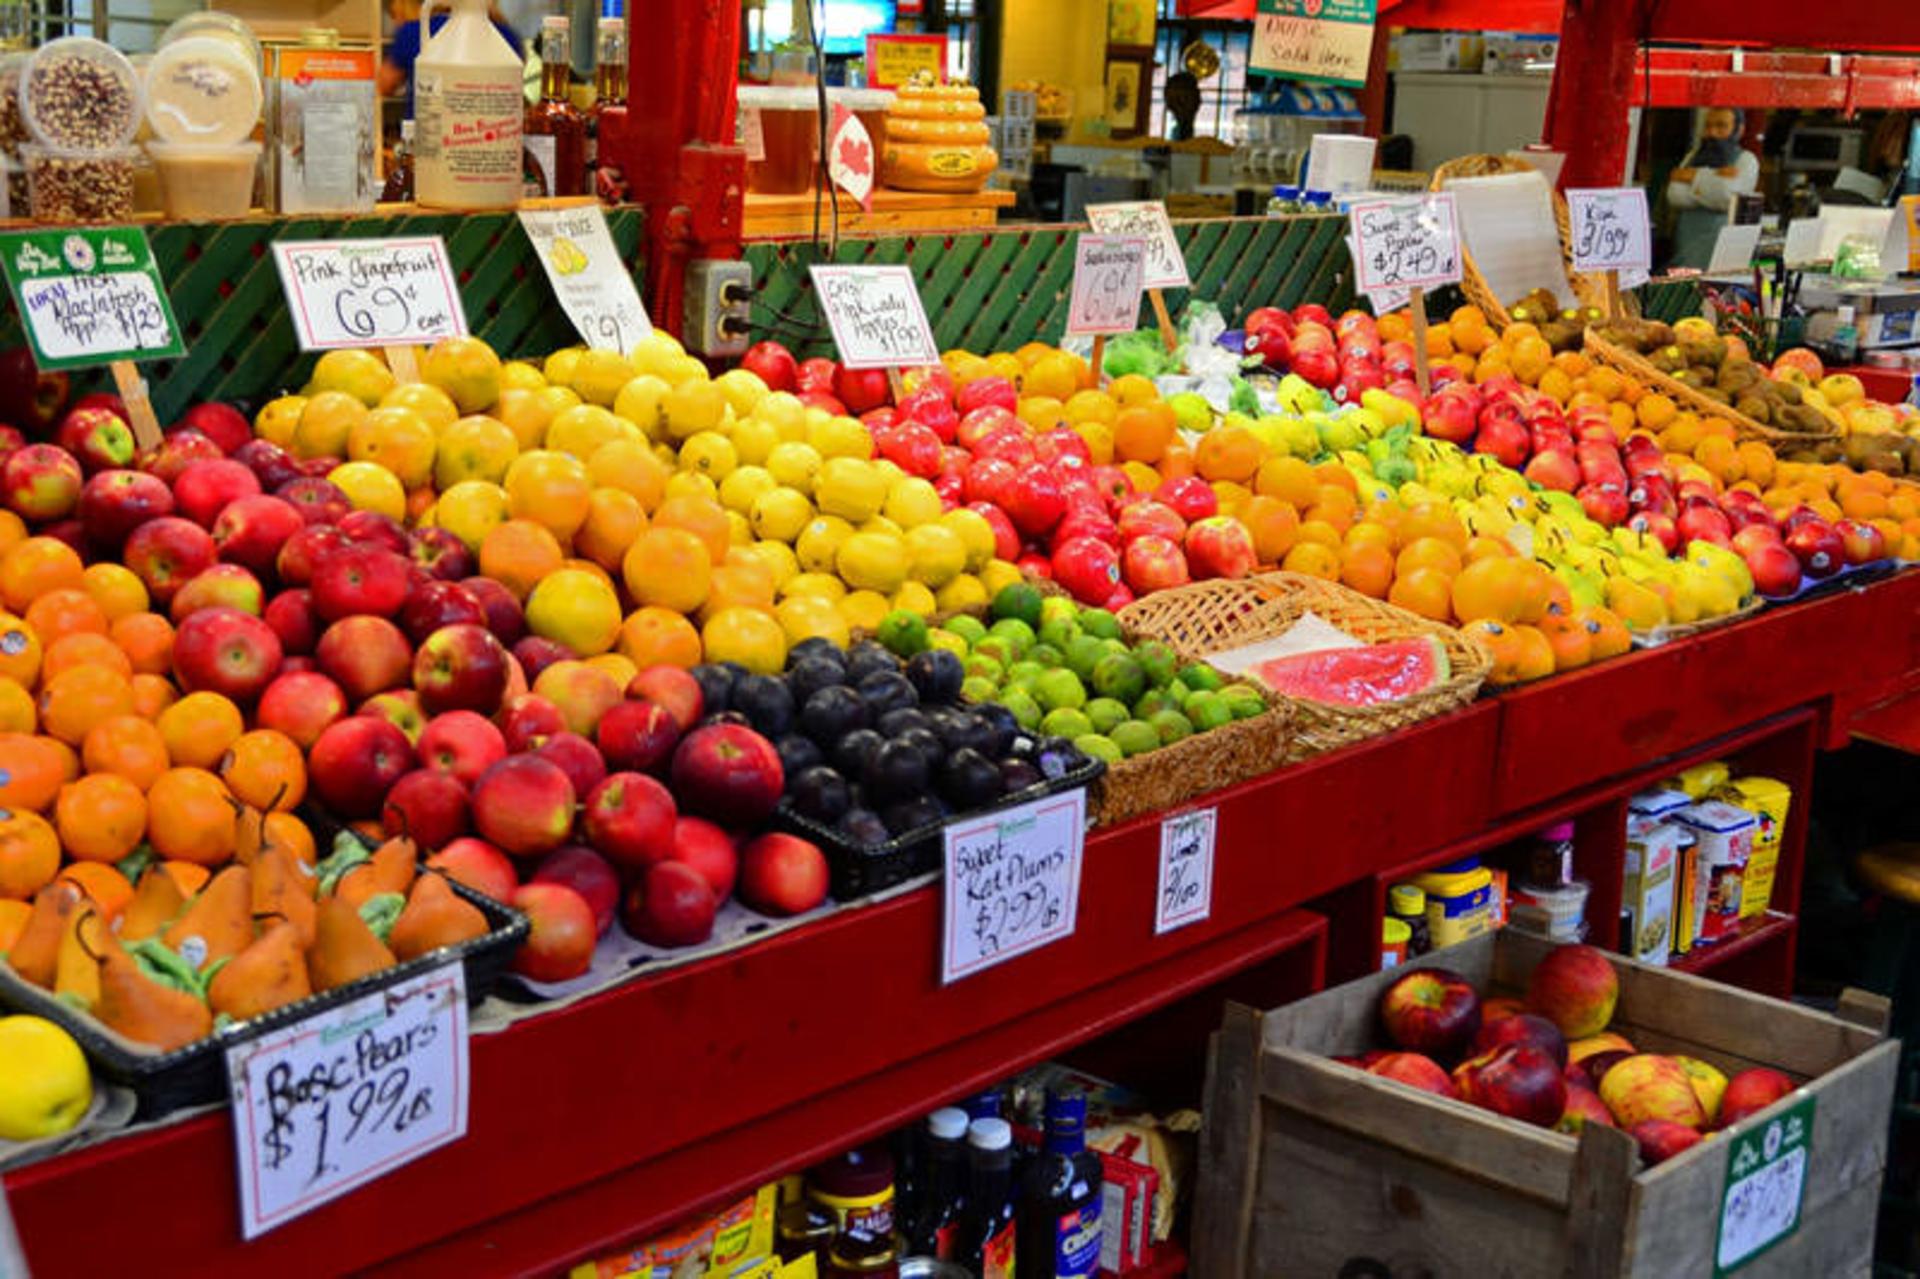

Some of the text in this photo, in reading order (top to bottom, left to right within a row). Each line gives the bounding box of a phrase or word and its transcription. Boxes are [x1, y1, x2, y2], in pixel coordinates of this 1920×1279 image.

[295, 255, 342, 283] Pink
[265, 1060, 354, 1126] Bosc
[354, 1027, 437, 1079] Pears
